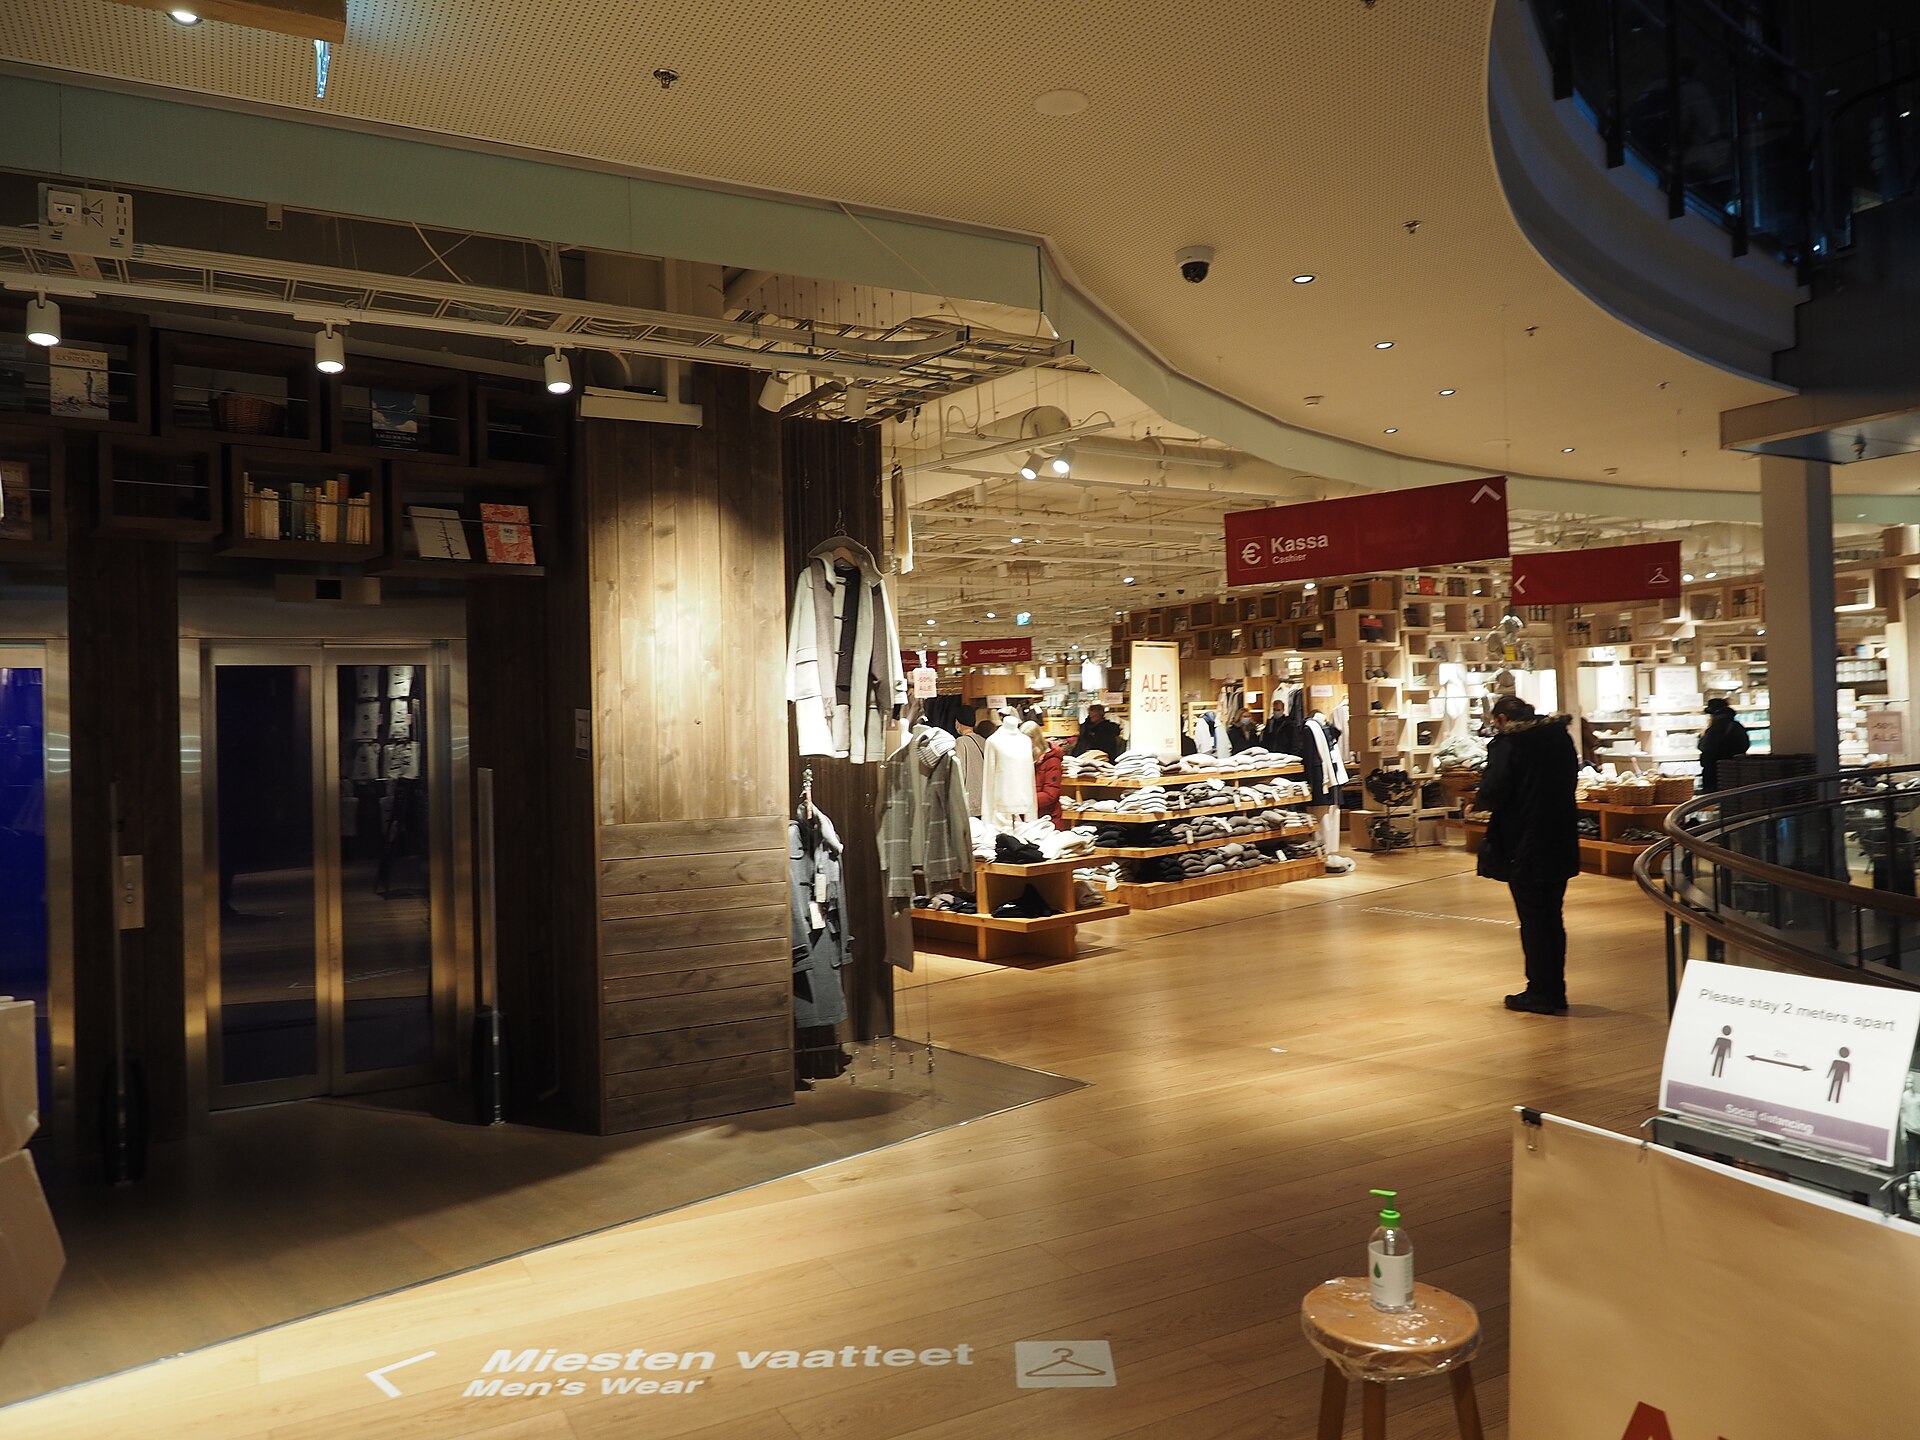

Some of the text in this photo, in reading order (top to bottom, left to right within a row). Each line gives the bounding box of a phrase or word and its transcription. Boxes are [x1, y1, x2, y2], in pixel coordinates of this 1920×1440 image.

[1270, 534, 1329, 554] Kassa
[1272, 553, 1307, 564] Cashier
[1141, 674, 1168, 692] ALE
[1140, 696, 1171, 713] -50%
[1699, 988, 1896, 1032] Please stay 2 meters apart
[1724, 1103, 1815, 1136] Social distancing
[480, 1343, 975, 1373] Miesten vaatteet
[463, 1377, 705, 1397] Men's Wear
